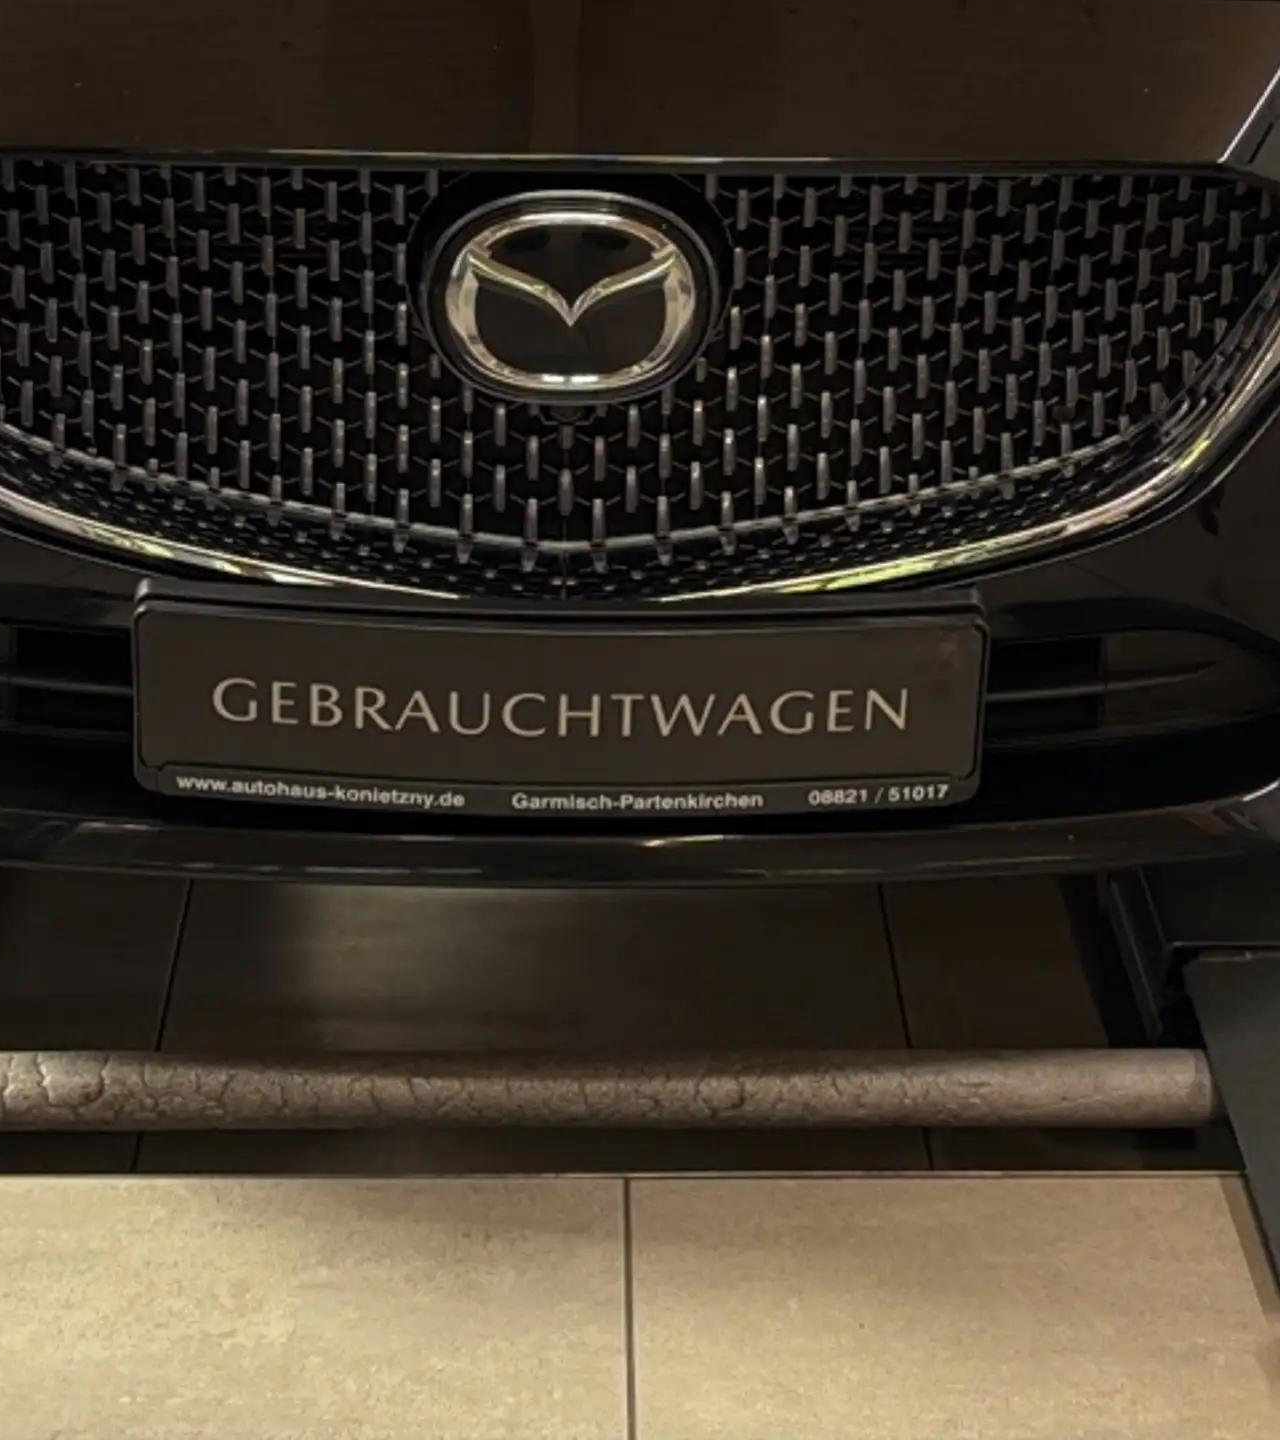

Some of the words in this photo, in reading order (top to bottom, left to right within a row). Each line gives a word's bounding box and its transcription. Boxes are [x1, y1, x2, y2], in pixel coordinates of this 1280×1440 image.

[212, 677, 909, 738] GEBRAUCHTWAGEN
[176, 773, 466, 809] www.autohaus-konietzny.de
[511, 791, 764, 812] Garmisch-Partenkirchen
[808, 789, 869, 805] 08821
[889, 784, 949, 802] 51017
